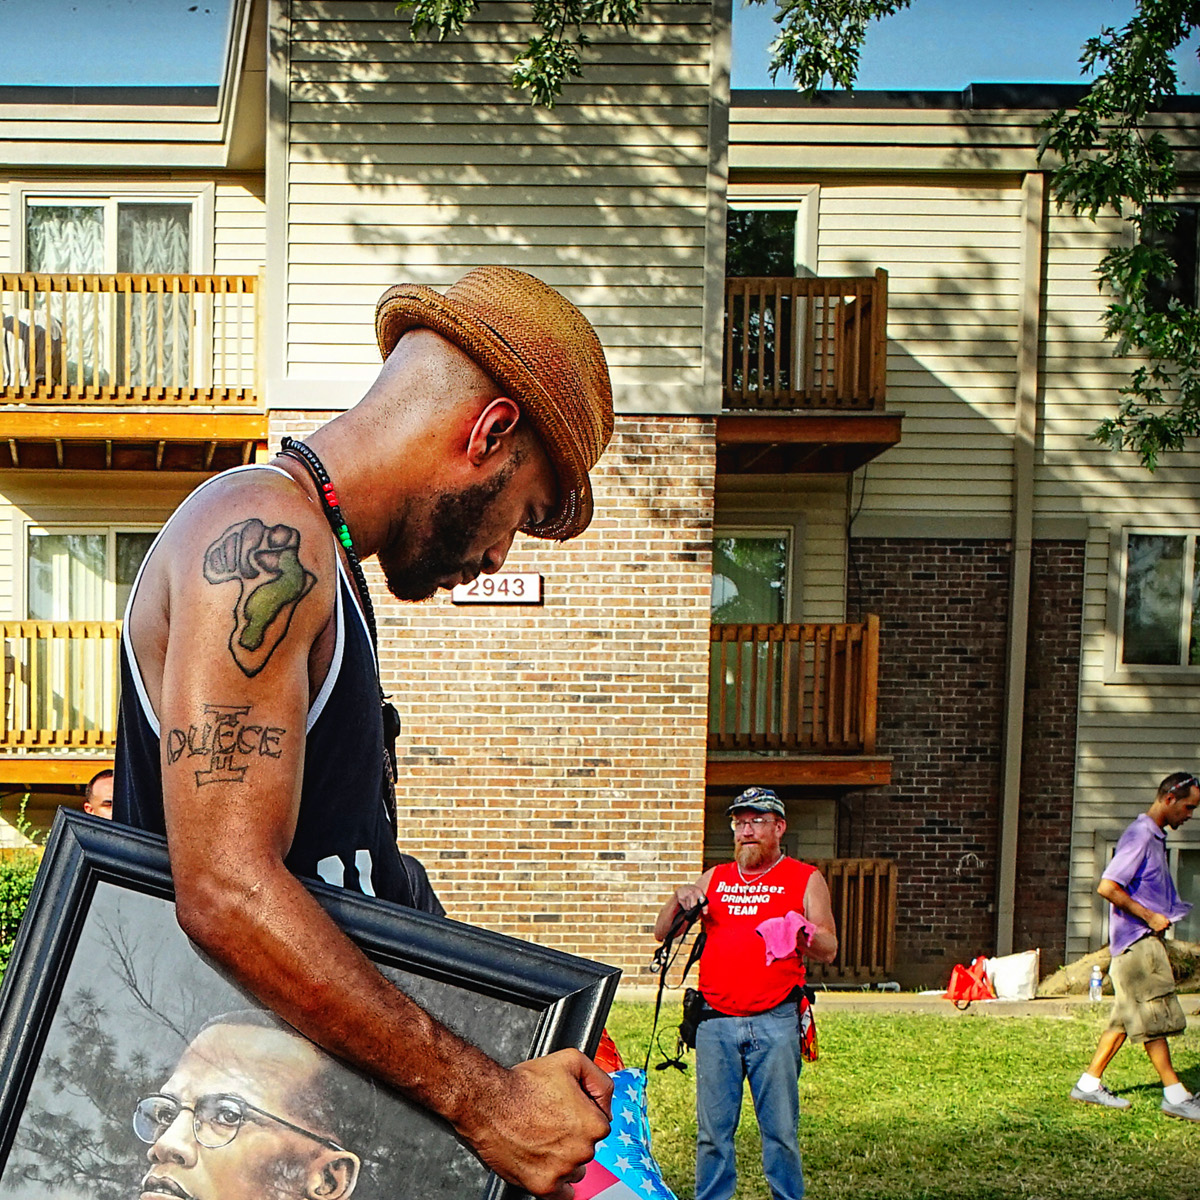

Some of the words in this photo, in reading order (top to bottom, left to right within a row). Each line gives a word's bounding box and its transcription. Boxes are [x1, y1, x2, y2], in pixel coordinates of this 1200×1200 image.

[467, 578, 525, 597] 2943
[715, 881, 784, 894] Budweiser
[721, 894, 770, 904] DRINKING
[728, 905, 758, 915] TEAM
